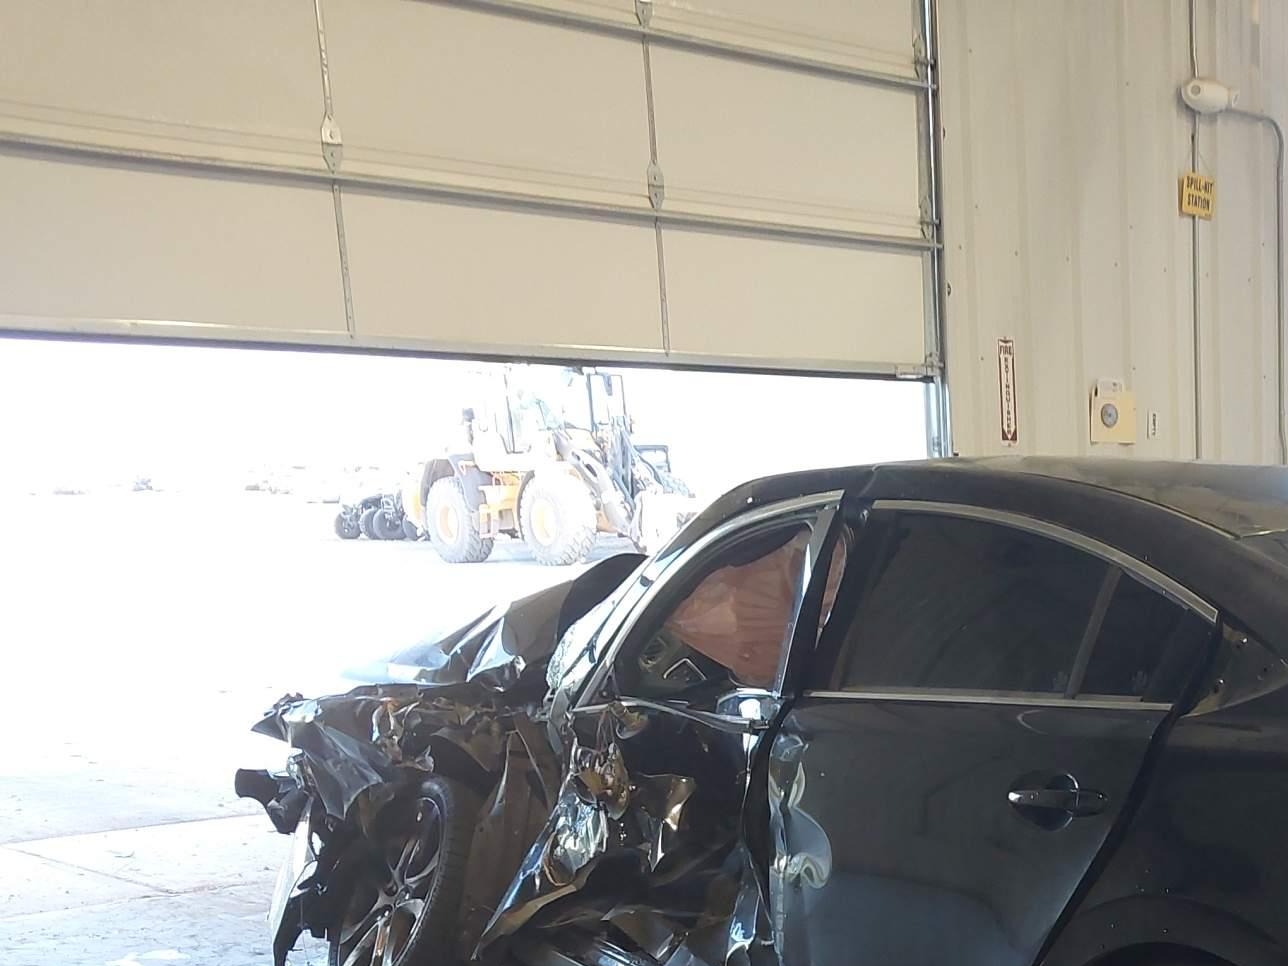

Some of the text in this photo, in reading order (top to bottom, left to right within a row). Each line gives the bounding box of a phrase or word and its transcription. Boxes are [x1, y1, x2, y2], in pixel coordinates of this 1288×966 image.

[1187, 193, 1210, 211] STATION
[999, 345, 1013, 355] FIRE
[1003, 356, 1013, 434] EXTINGUISHER
